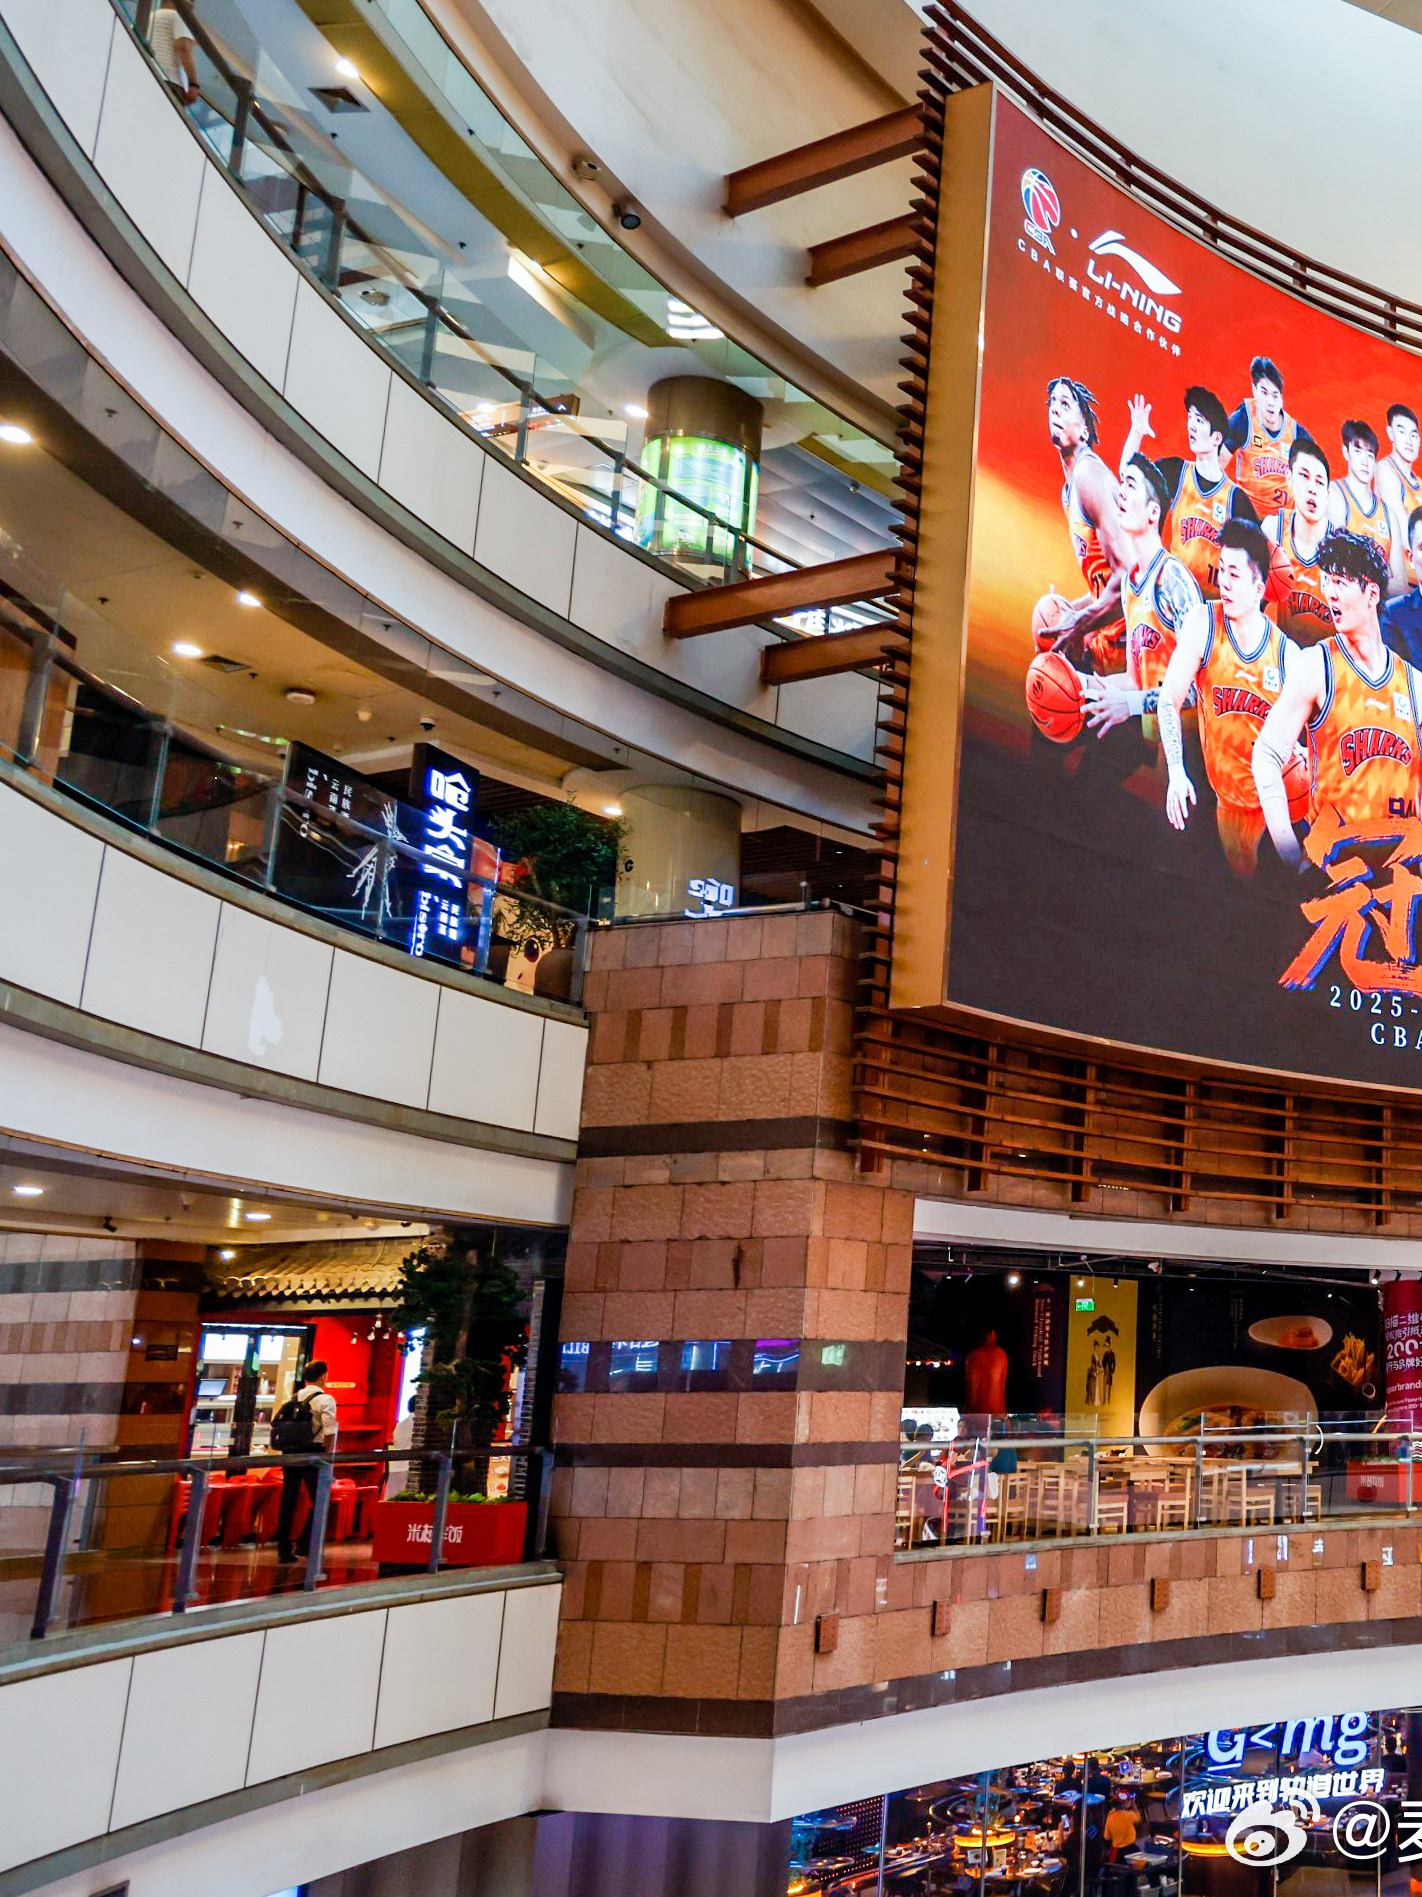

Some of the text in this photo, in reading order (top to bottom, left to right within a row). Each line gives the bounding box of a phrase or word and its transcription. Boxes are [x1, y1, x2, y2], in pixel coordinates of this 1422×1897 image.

[1086, 259, 1182, 333] LI-NING
[1212, 686, 1272, 719] SHARK
[1340, 727, 1413, 777] SHARKS
[416, 890, 432, 957] bistro
[407, 1523, 463, 1544] 米村饭
